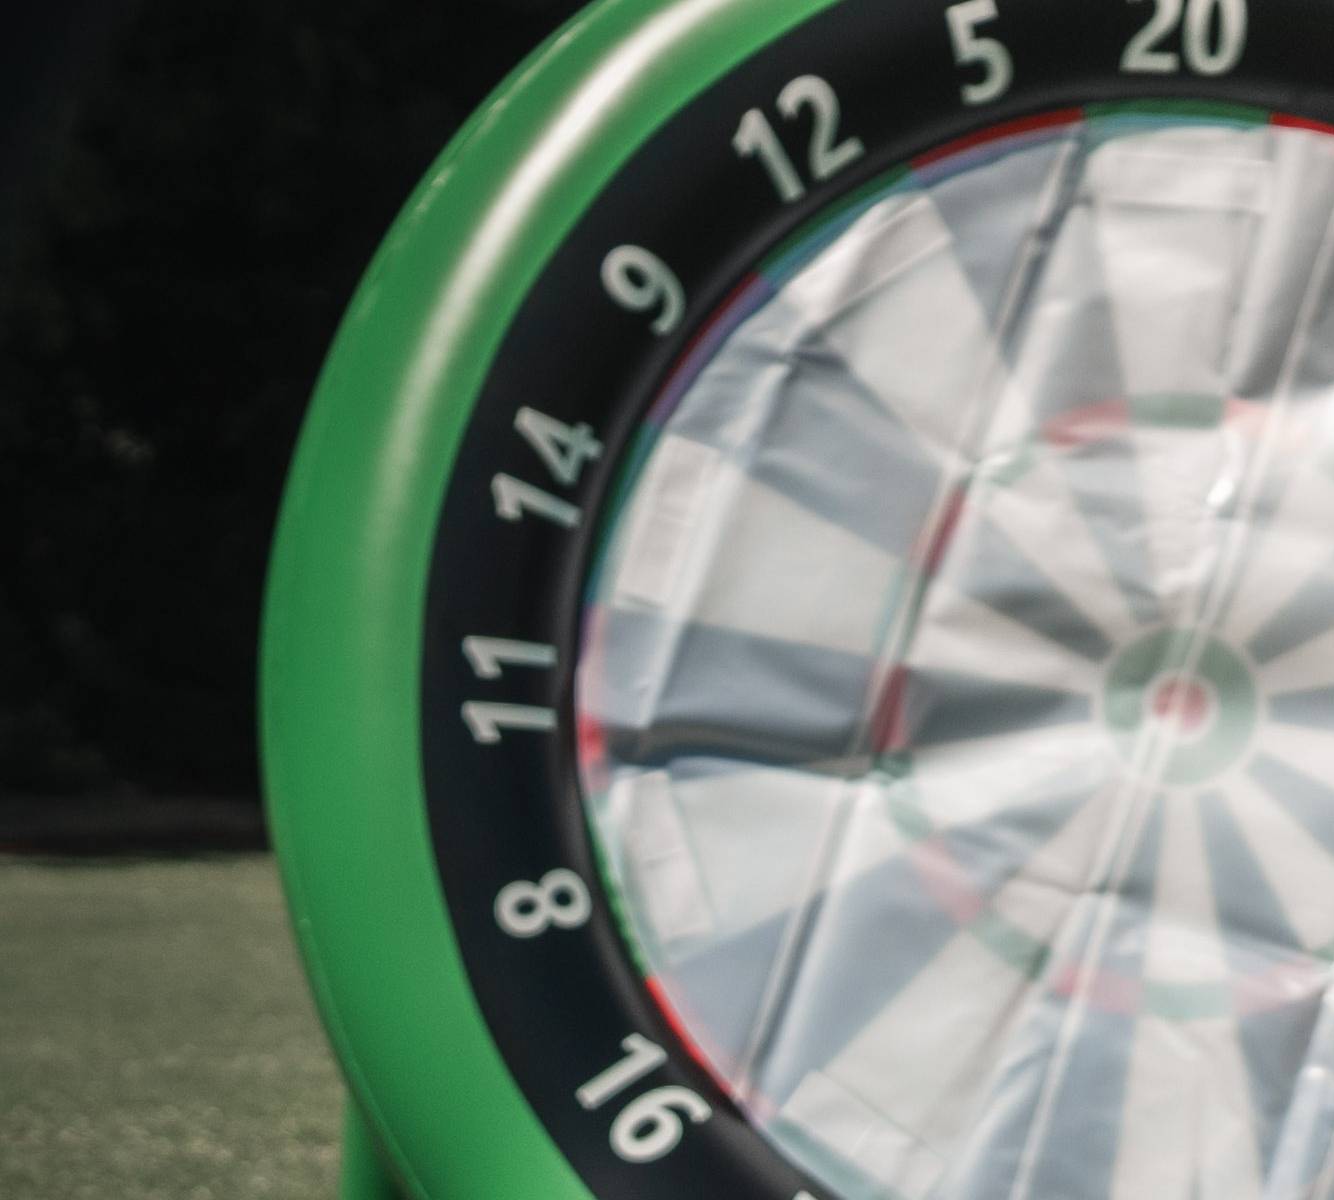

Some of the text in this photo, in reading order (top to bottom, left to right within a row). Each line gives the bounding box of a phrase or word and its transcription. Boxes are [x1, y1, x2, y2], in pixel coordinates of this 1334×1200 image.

[946, 0, 1014, 104] 5
[1119, 0, 1248, 76] 20
[732, 73, 866, 203] 12
[601, 243, 686, 336] 9
[490, 405, 604, 528] 14
[461, 635, 557, 743] 11
[494, 868, 592, 938] 8
[575, 1032, 712, 1163] 16
